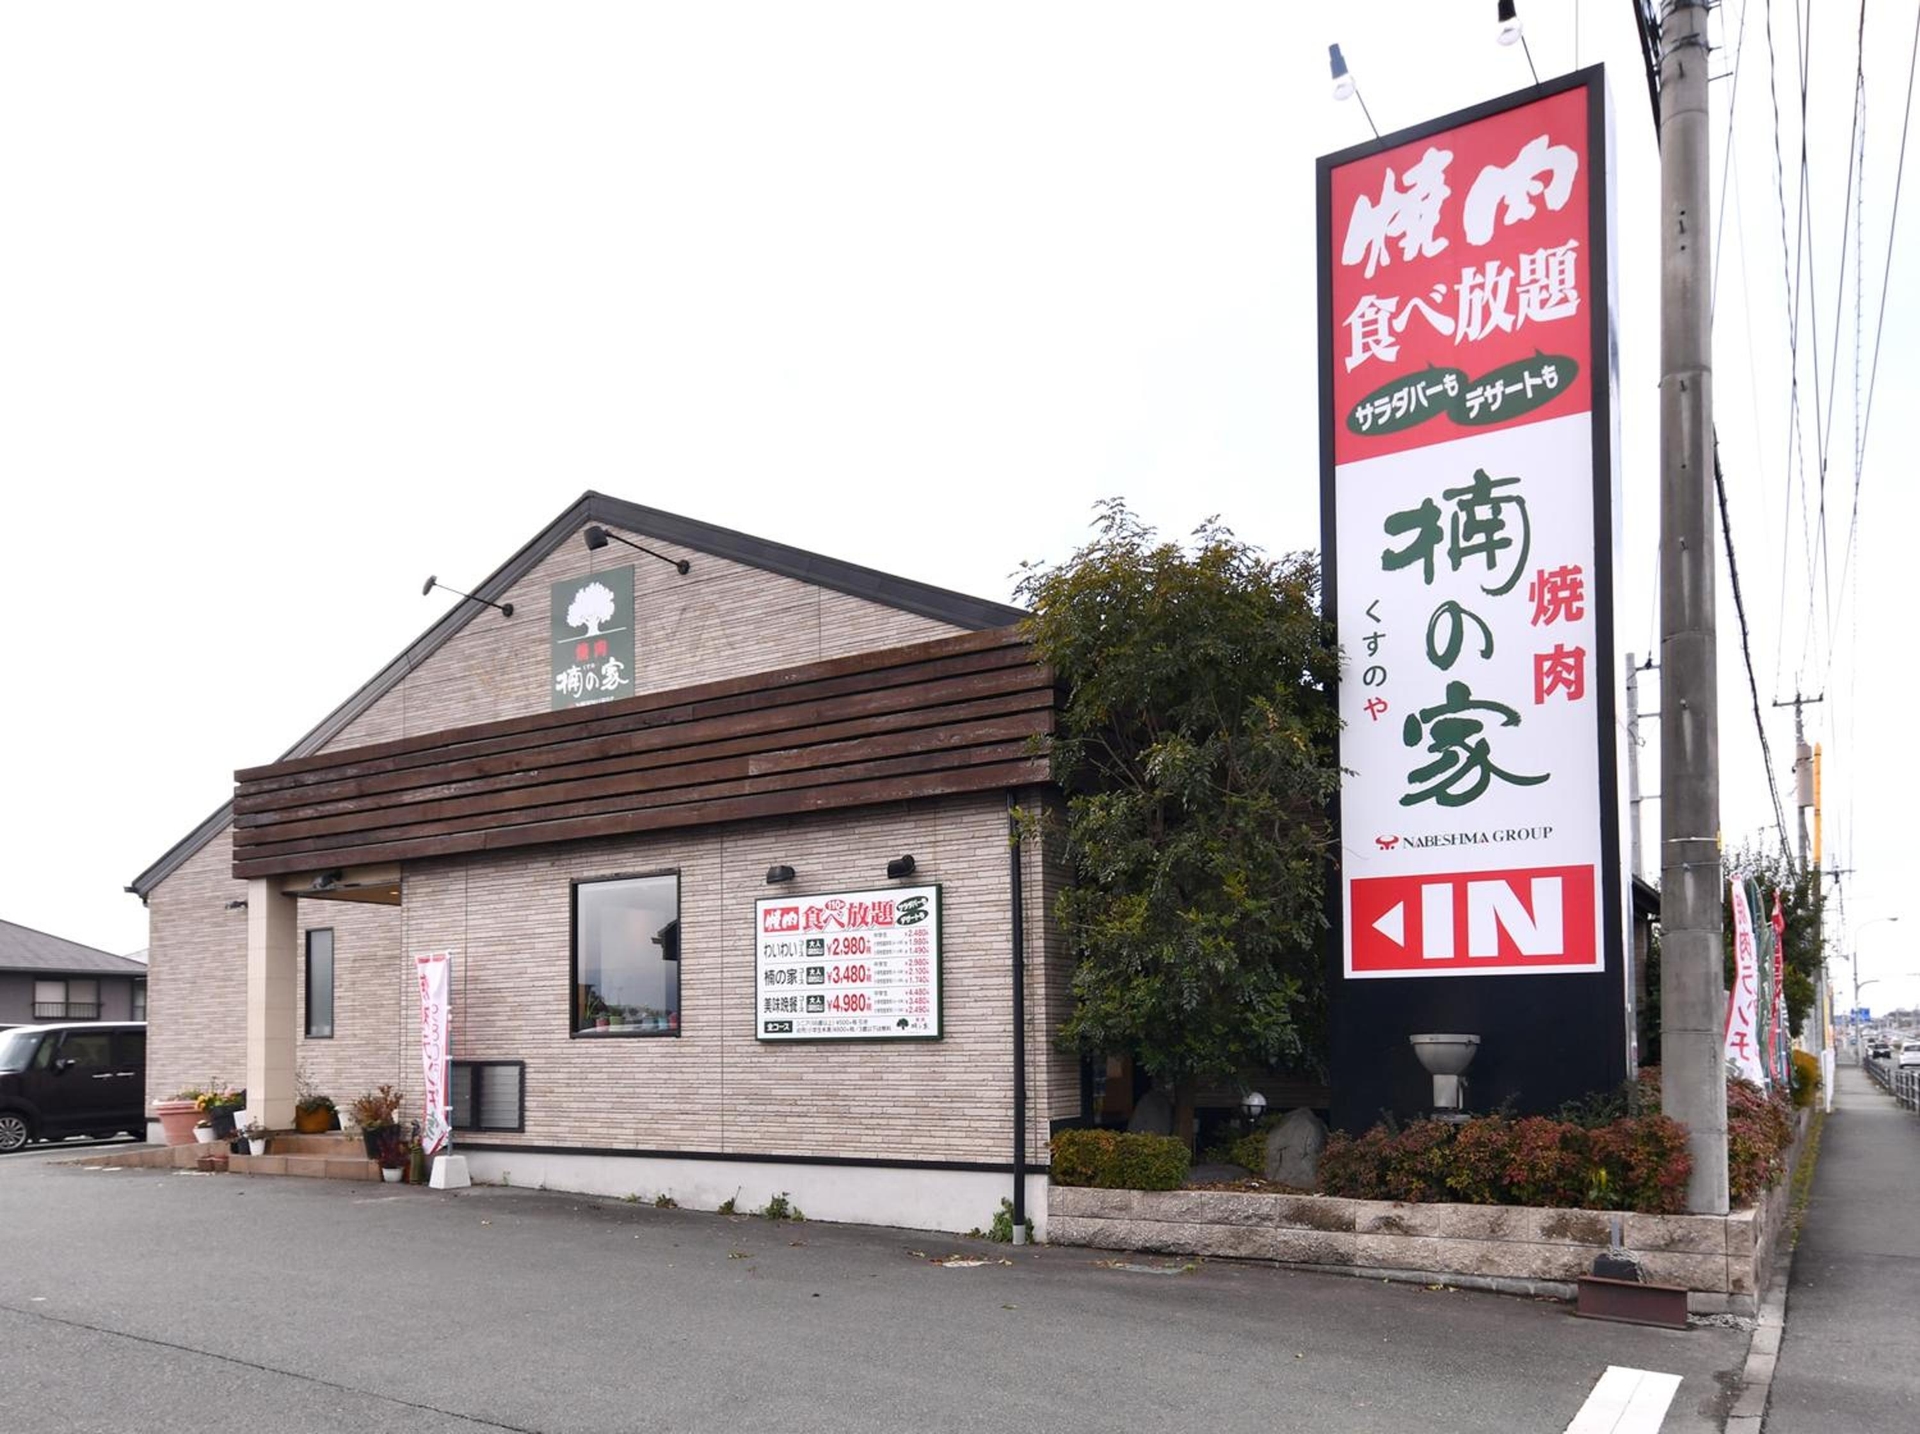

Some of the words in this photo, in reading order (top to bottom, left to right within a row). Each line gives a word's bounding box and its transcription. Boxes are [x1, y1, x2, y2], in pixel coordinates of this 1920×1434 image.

[1341, 134, 1579, 279] 焼肉
[1342, 239, 1581, 373] 食べ放題
[1355, 374, 1459, 431] サラダバーも
[1465, 364, 1559, 418] デザートも
[1362, 599, 1388, 721] くすのや
[1381, 468, 1551, 807] 楠の家
[1528, 565, 1586, 705] 焼肉
[556, 656, 630, 698] 楠の家
[1492, 826, 1553, 842] GROUP
[803, 900, 893, 931] 食べ放題
[1421, 876, 1564, 959] IN
[763, 942, 798, 957] わいわい
[764, 969, 797, 986] 楠の家
